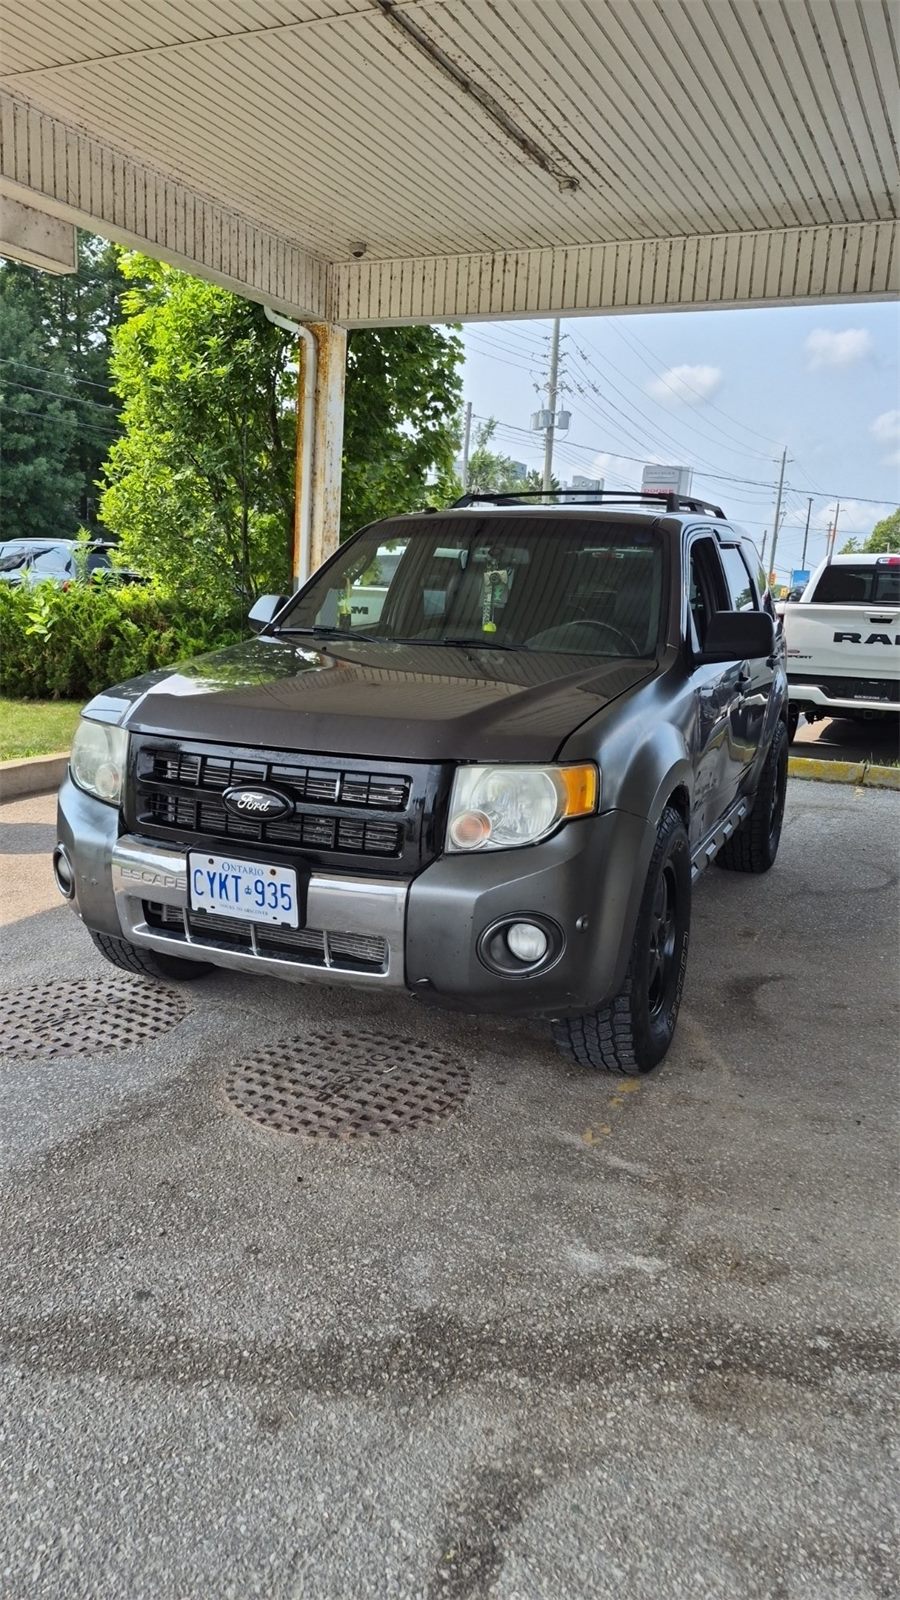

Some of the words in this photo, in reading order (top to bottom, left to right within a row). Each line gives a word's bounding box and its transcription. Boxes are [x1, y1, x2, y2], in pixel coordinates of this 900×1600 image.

[833, 631, 900, 645] RA
[237, 793, 271, 811] Ford
[120, 866, 187, 891] ESCAPE
[222, 861, 264, 876] ONTARIO
[193, 869, 241, 902] CYKT
[254, 879, 292, 911] 935
[313, 1053, 391, 1101] DANGER
